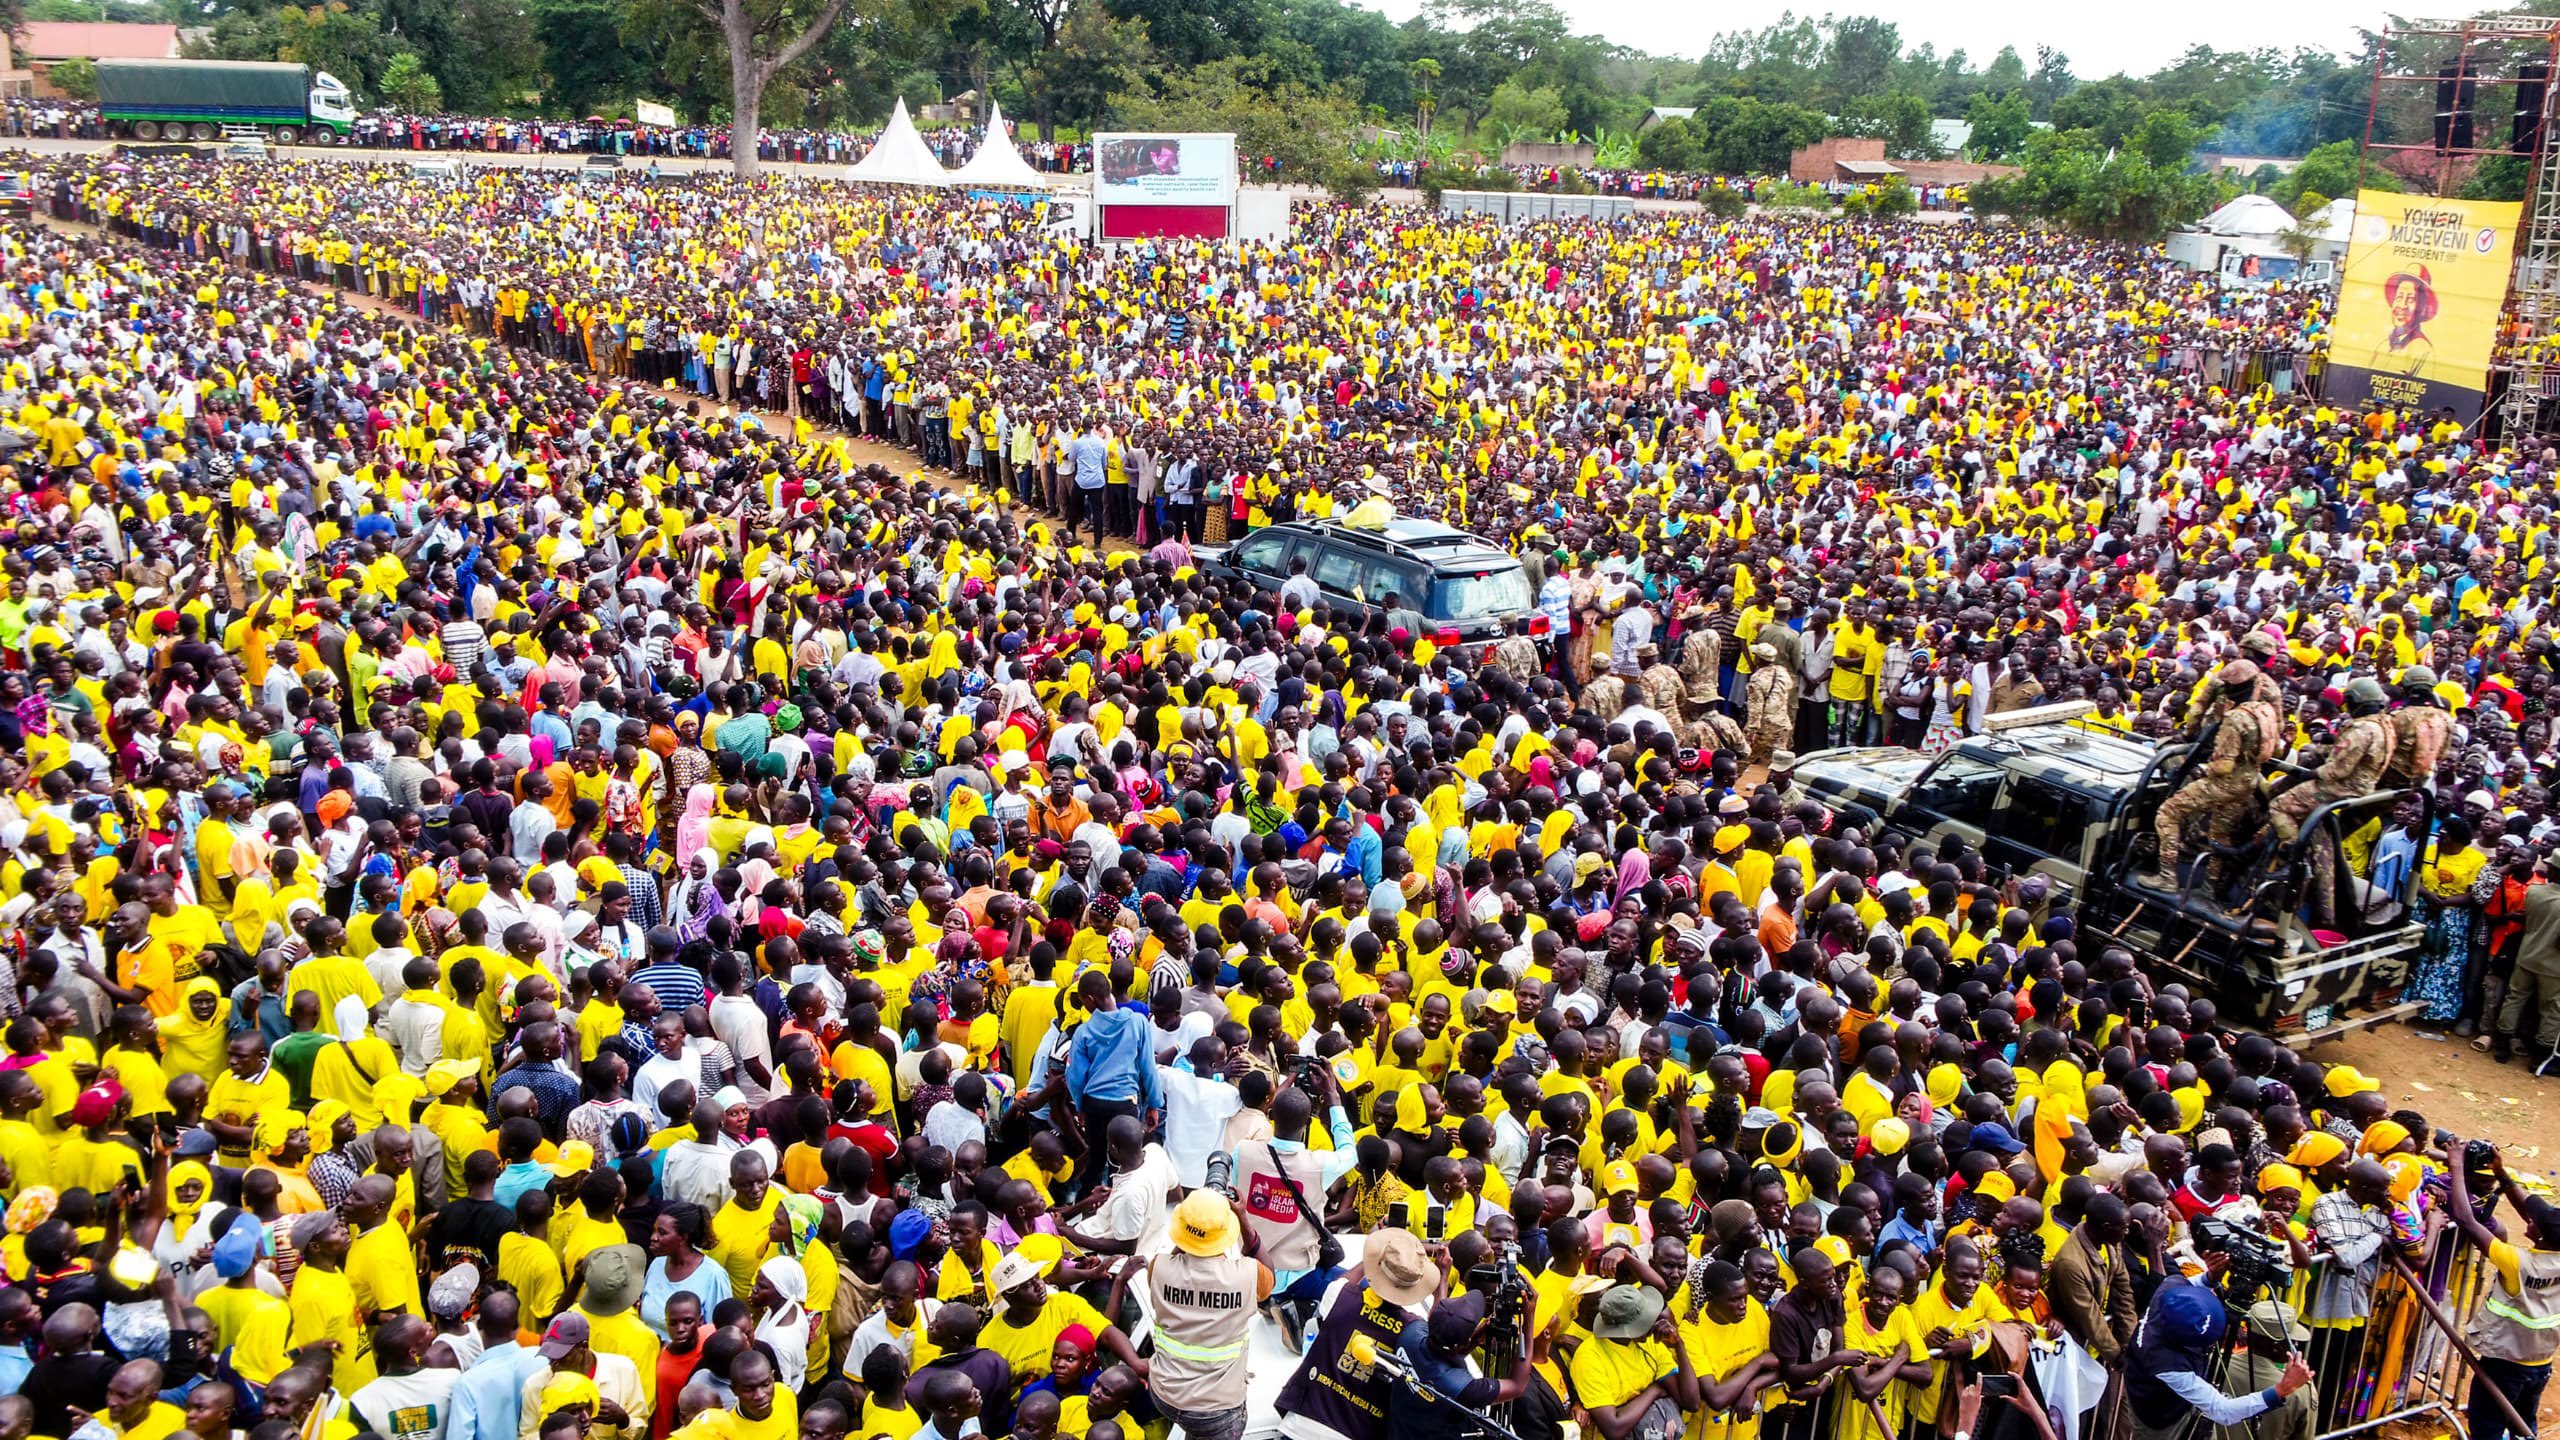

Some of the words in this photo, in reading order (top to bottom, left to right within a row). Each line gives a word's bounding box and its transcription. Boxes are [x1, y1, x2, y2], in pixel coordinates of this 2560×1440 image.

[2403, 208, 2464, 230] YOWERI
[2389, 225, 2469, 250] MUSEVENI
[2393, 245, 2446, 261] PRESIDENT
[2370, 374, 2427, 395] PROTECTING
[2372, 386, 2391, 400] THE
[2391, 390, 2420, 405] GAINS
[1268, 1203, 1294, 1215] MEDIA
[1270, 1195, 1295, 1206] ISLAM
[1186, 1224, 1206, 1239] NRM
[2525, 1275, 2552, 1290] NRM
[1163, 1284, 1195, 1306] NRM
[1199, 1291, 1242, 1309] MEDIA
[1360, 1304, 1404, 1334] PRESS
[1350, 1394, 1369, 1410] MEDIA
